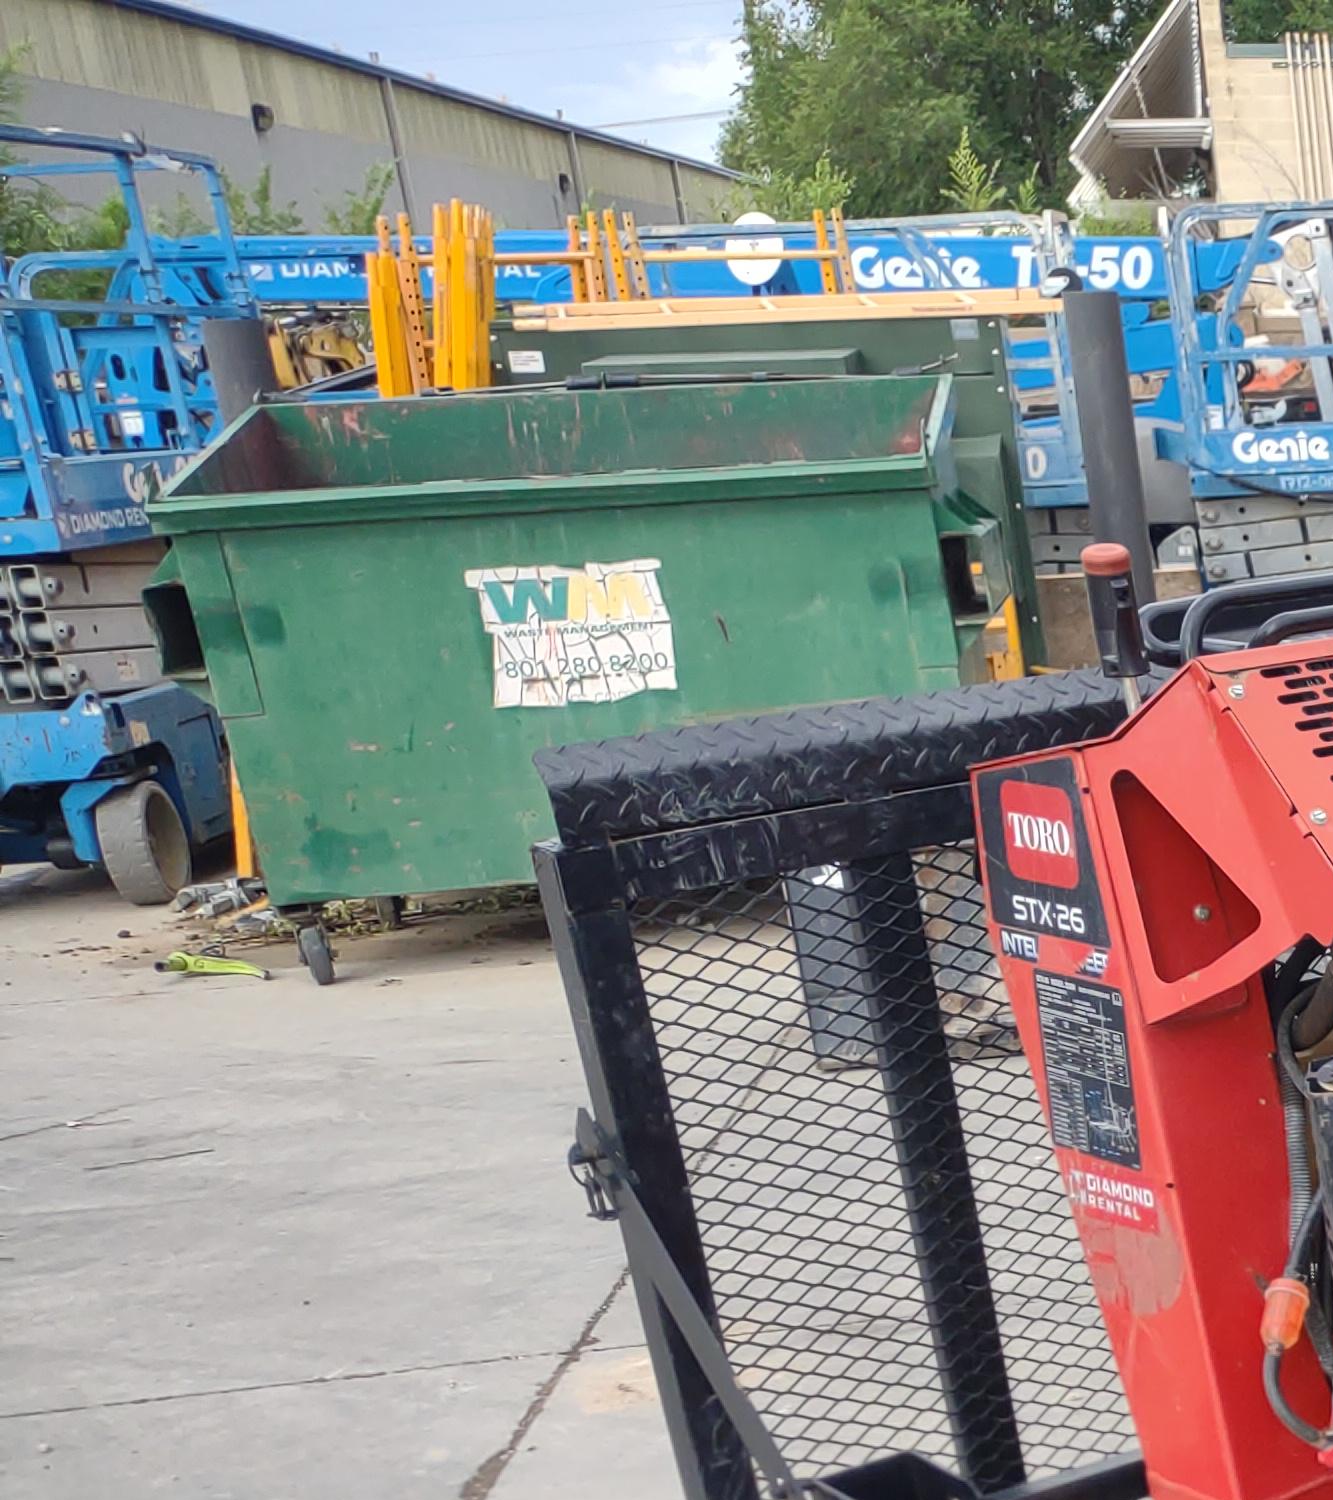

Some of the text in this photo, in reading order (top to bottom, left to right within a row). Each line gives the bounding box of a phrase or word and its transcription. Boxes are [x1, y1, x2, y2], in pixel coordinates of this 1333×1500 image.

[850, 244, 1154, 290] Genie T-50
[1232, 431, 1330, 464] Genie
[70, 508, 126, 534] DIAMOND
[482, 575, 651, 624] WM
[505, 651, 668, 679] 801 280 8200
[1007, 811, 1071, 857] TORO
[1086, 1172, 1155, 1209] DIAMOND
[1088, 1193, 1142, 1222] RENTAL
